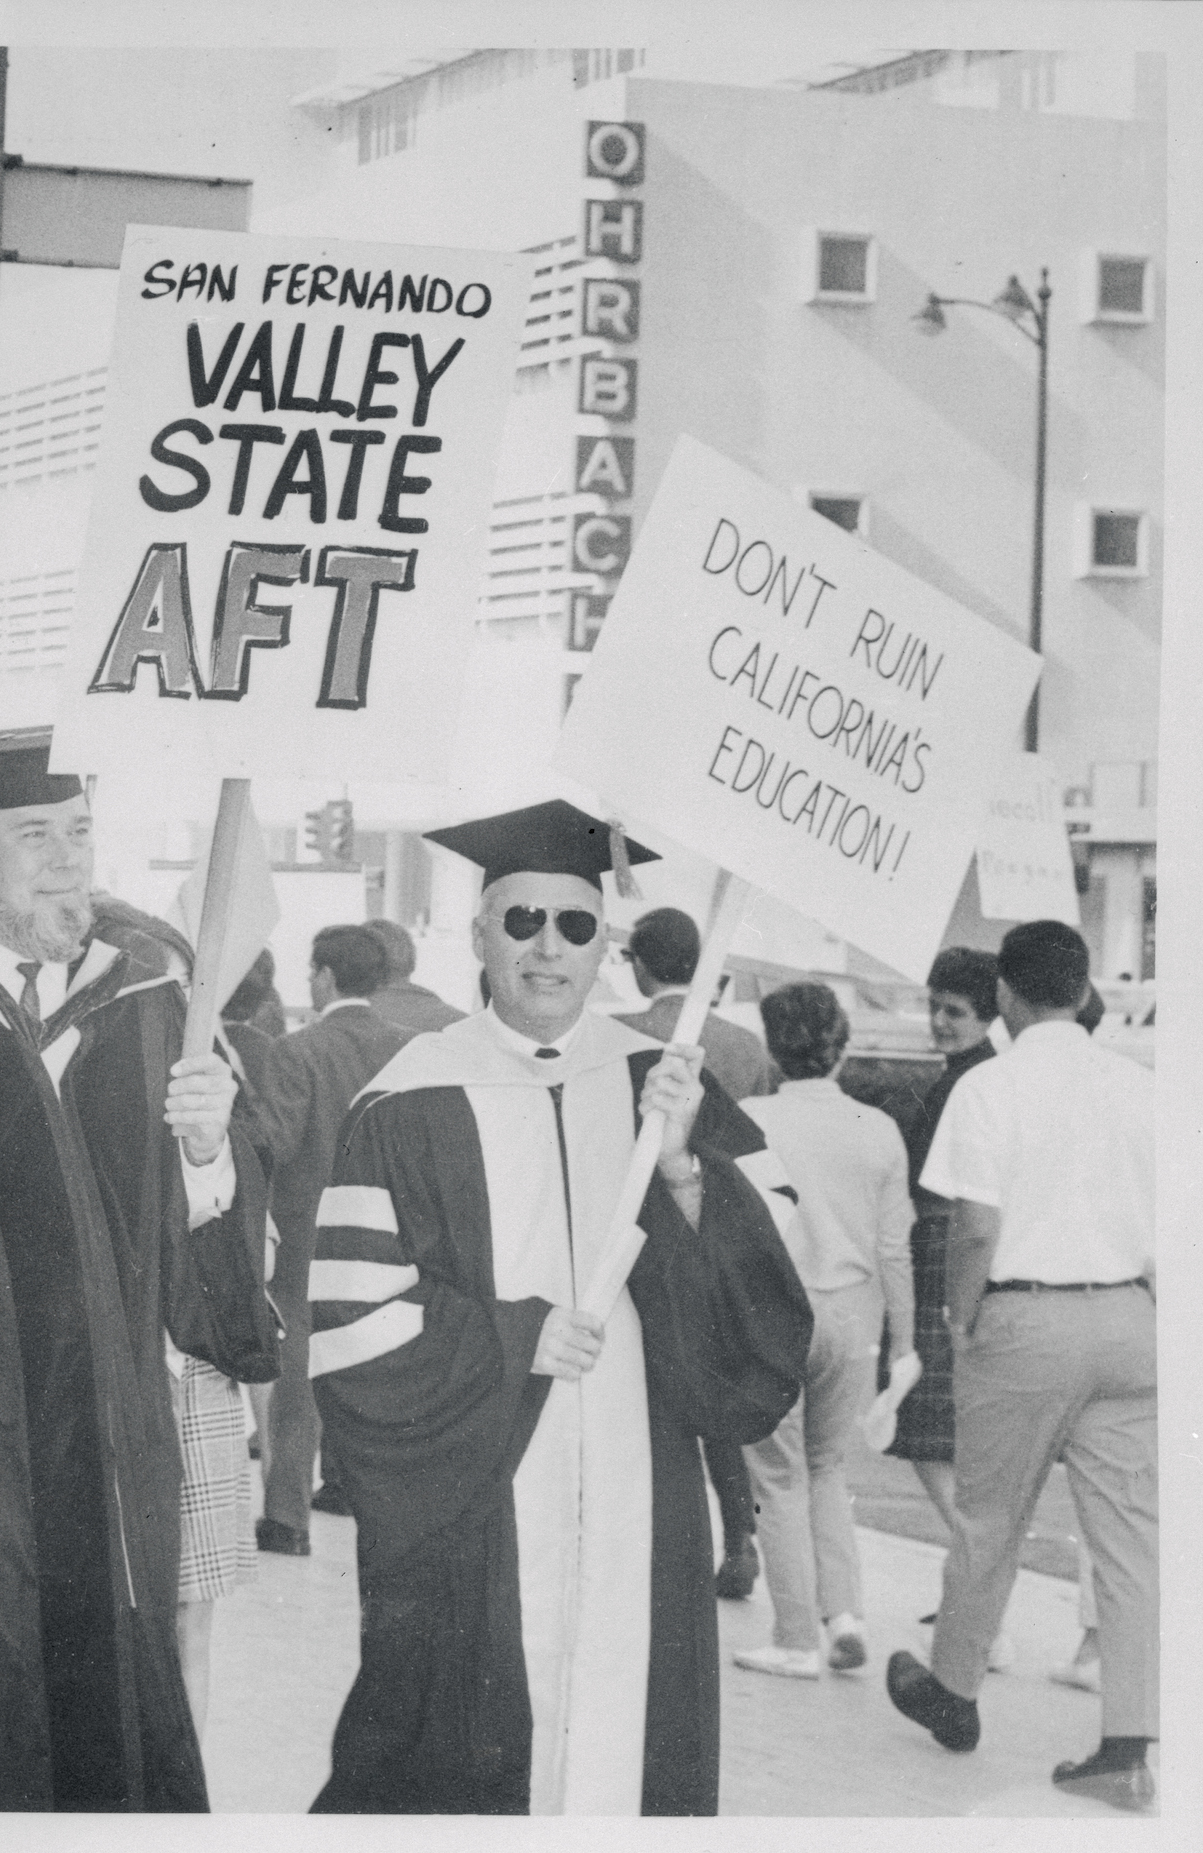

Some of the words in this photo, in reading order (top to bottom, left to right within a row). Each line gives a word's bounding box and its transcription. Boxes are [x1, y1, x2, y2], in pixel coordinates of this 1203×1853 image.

[140, 258, 238, 304] SAN
[261, 262, 493, 319] FERNANDO
[185, 318, 467, 428] VALLEY
[138, 417, 443, 535] STATE
[86, 540, 420, 711] AFT
[702, 517, 838, 631] DON'T
[849, 608, 945, 702] RUIN
[708, 625, 932, 794] CALIFORNIA'S
[708, 725, 911, 883] EDUCATION!
